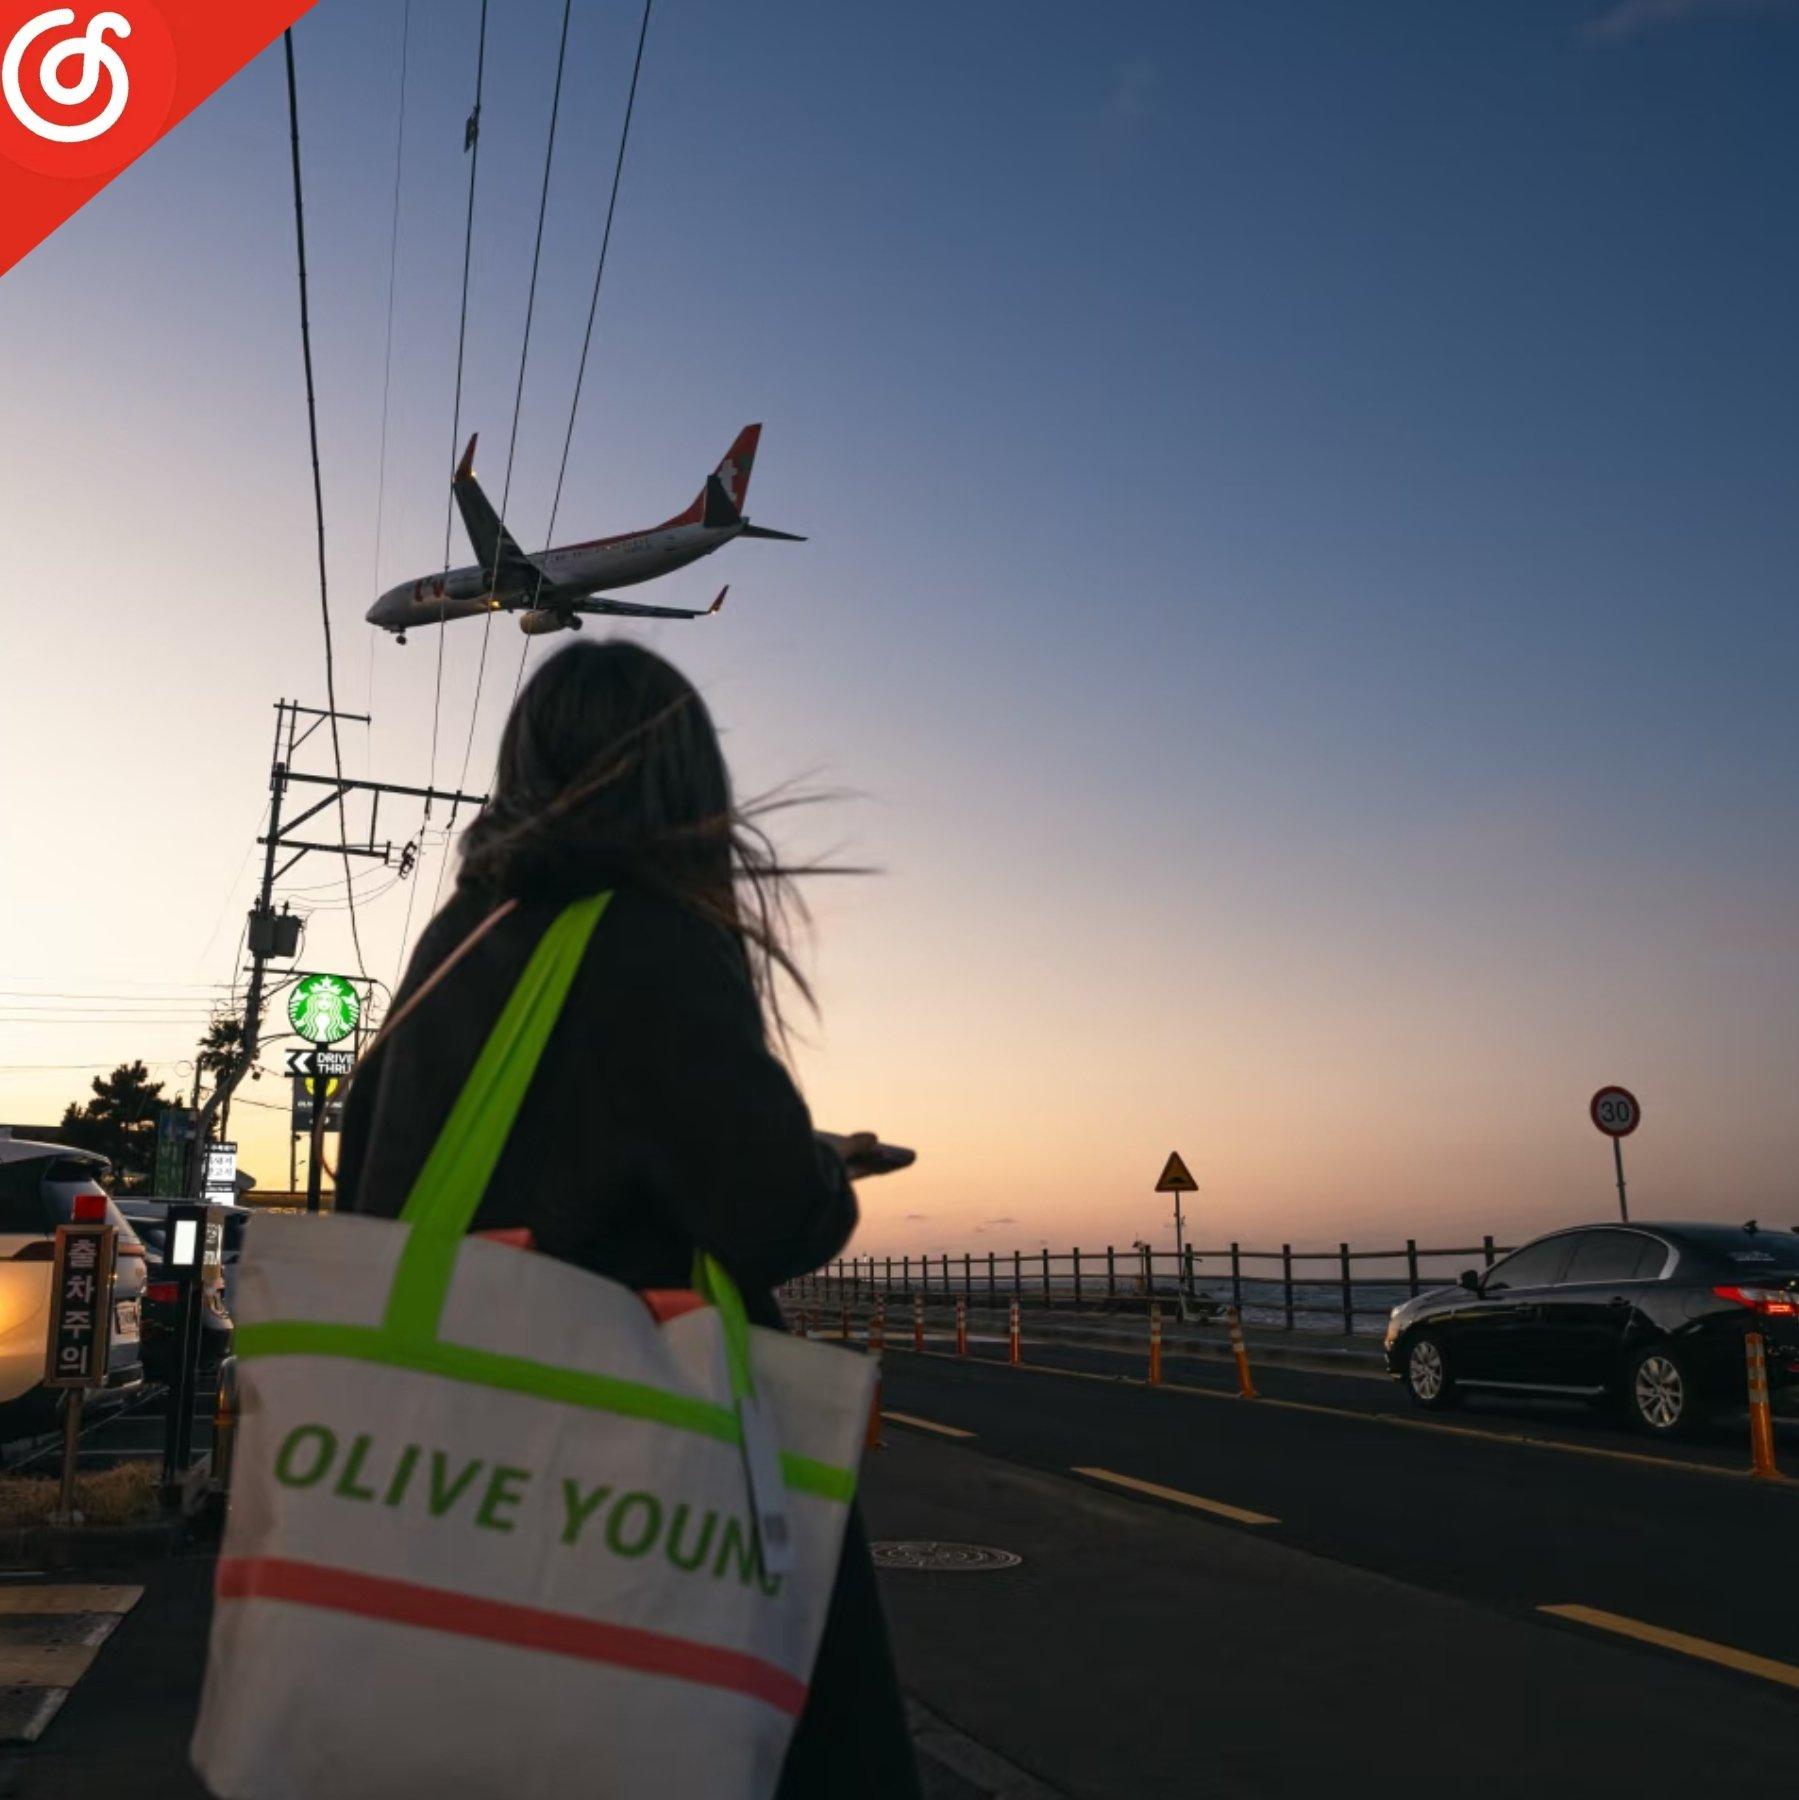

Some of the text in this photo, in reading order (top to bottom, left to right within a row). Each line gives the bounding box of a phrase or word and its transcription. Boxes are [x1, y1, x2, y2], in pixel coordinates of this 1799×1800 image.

[317, 1052, 355, 1063] DRIVE
[1602, 1100, 1630, 1122] 30
[58, 1239, 97, 1375] 출차주의
[273, 1424, 533, 1533] OLIVE
